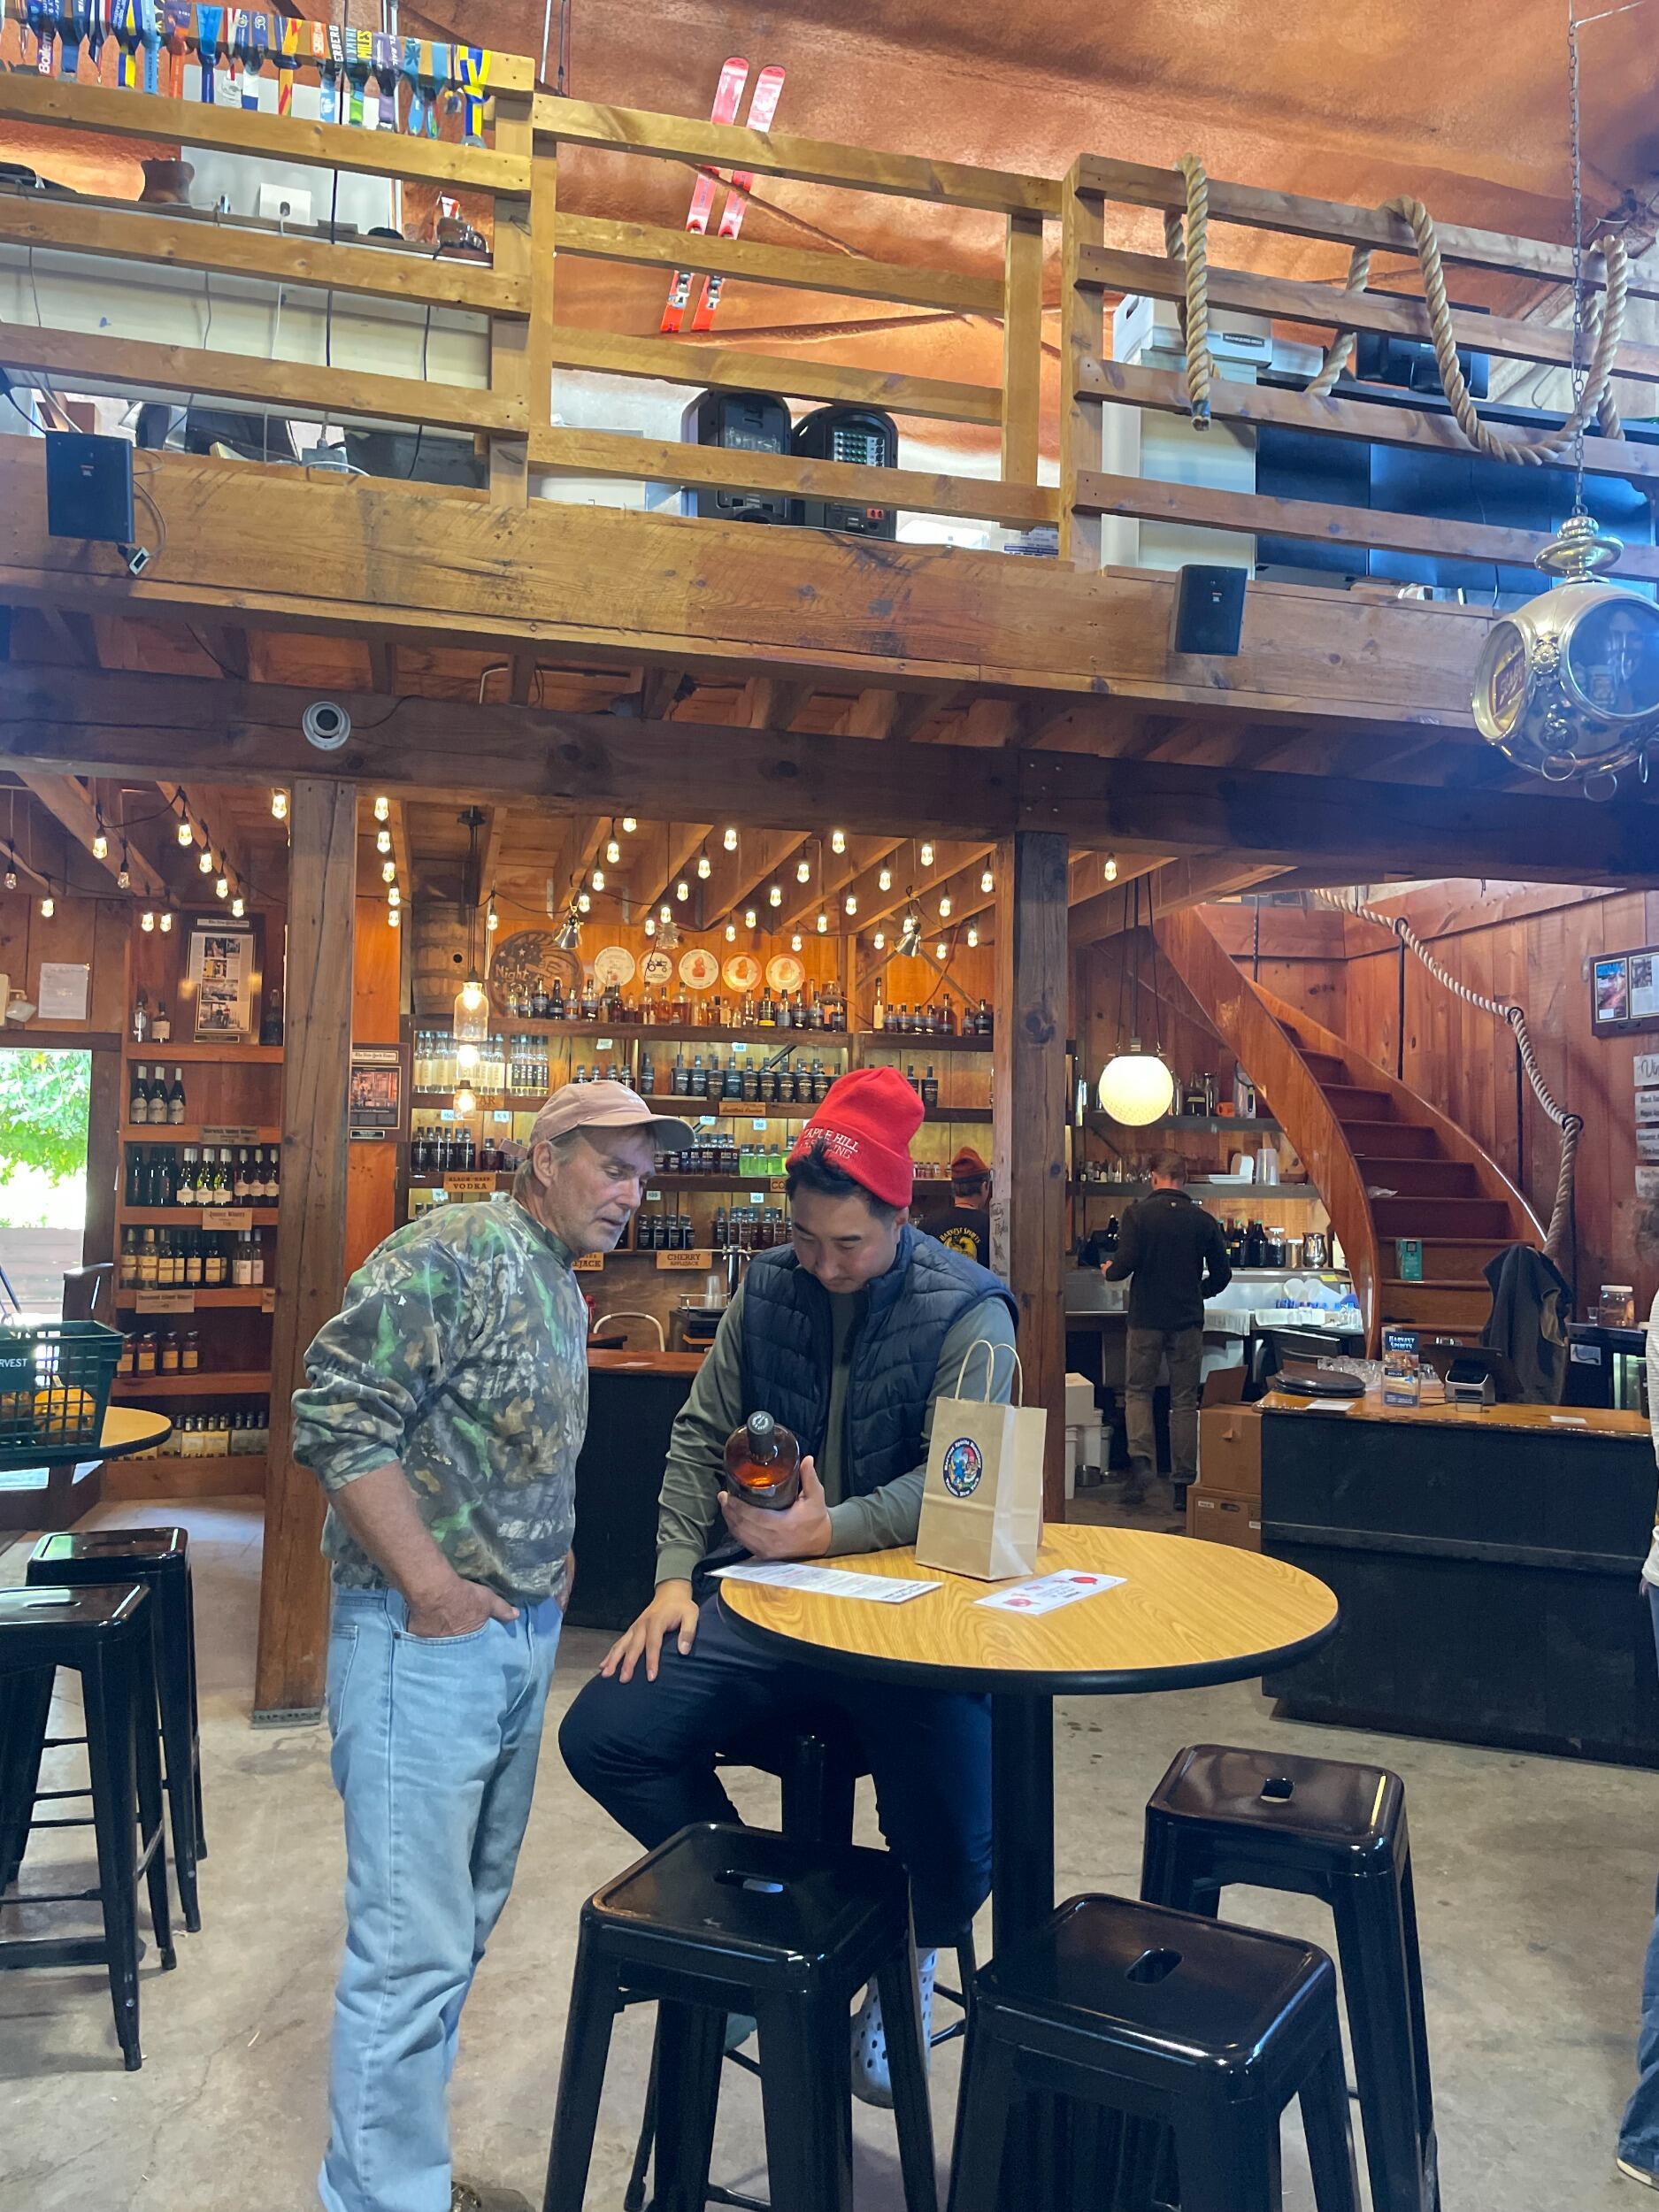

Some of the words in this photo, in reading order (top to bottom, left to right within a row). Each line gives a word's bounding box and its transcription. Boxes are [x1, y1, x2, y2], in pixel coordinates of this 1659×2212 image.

[357, 30, 372, 58] MILES
[495, 964, 529, 981] Night
[833, 1133, 858, 1153] HILL
[771, 1180, 786, 1190] CO
